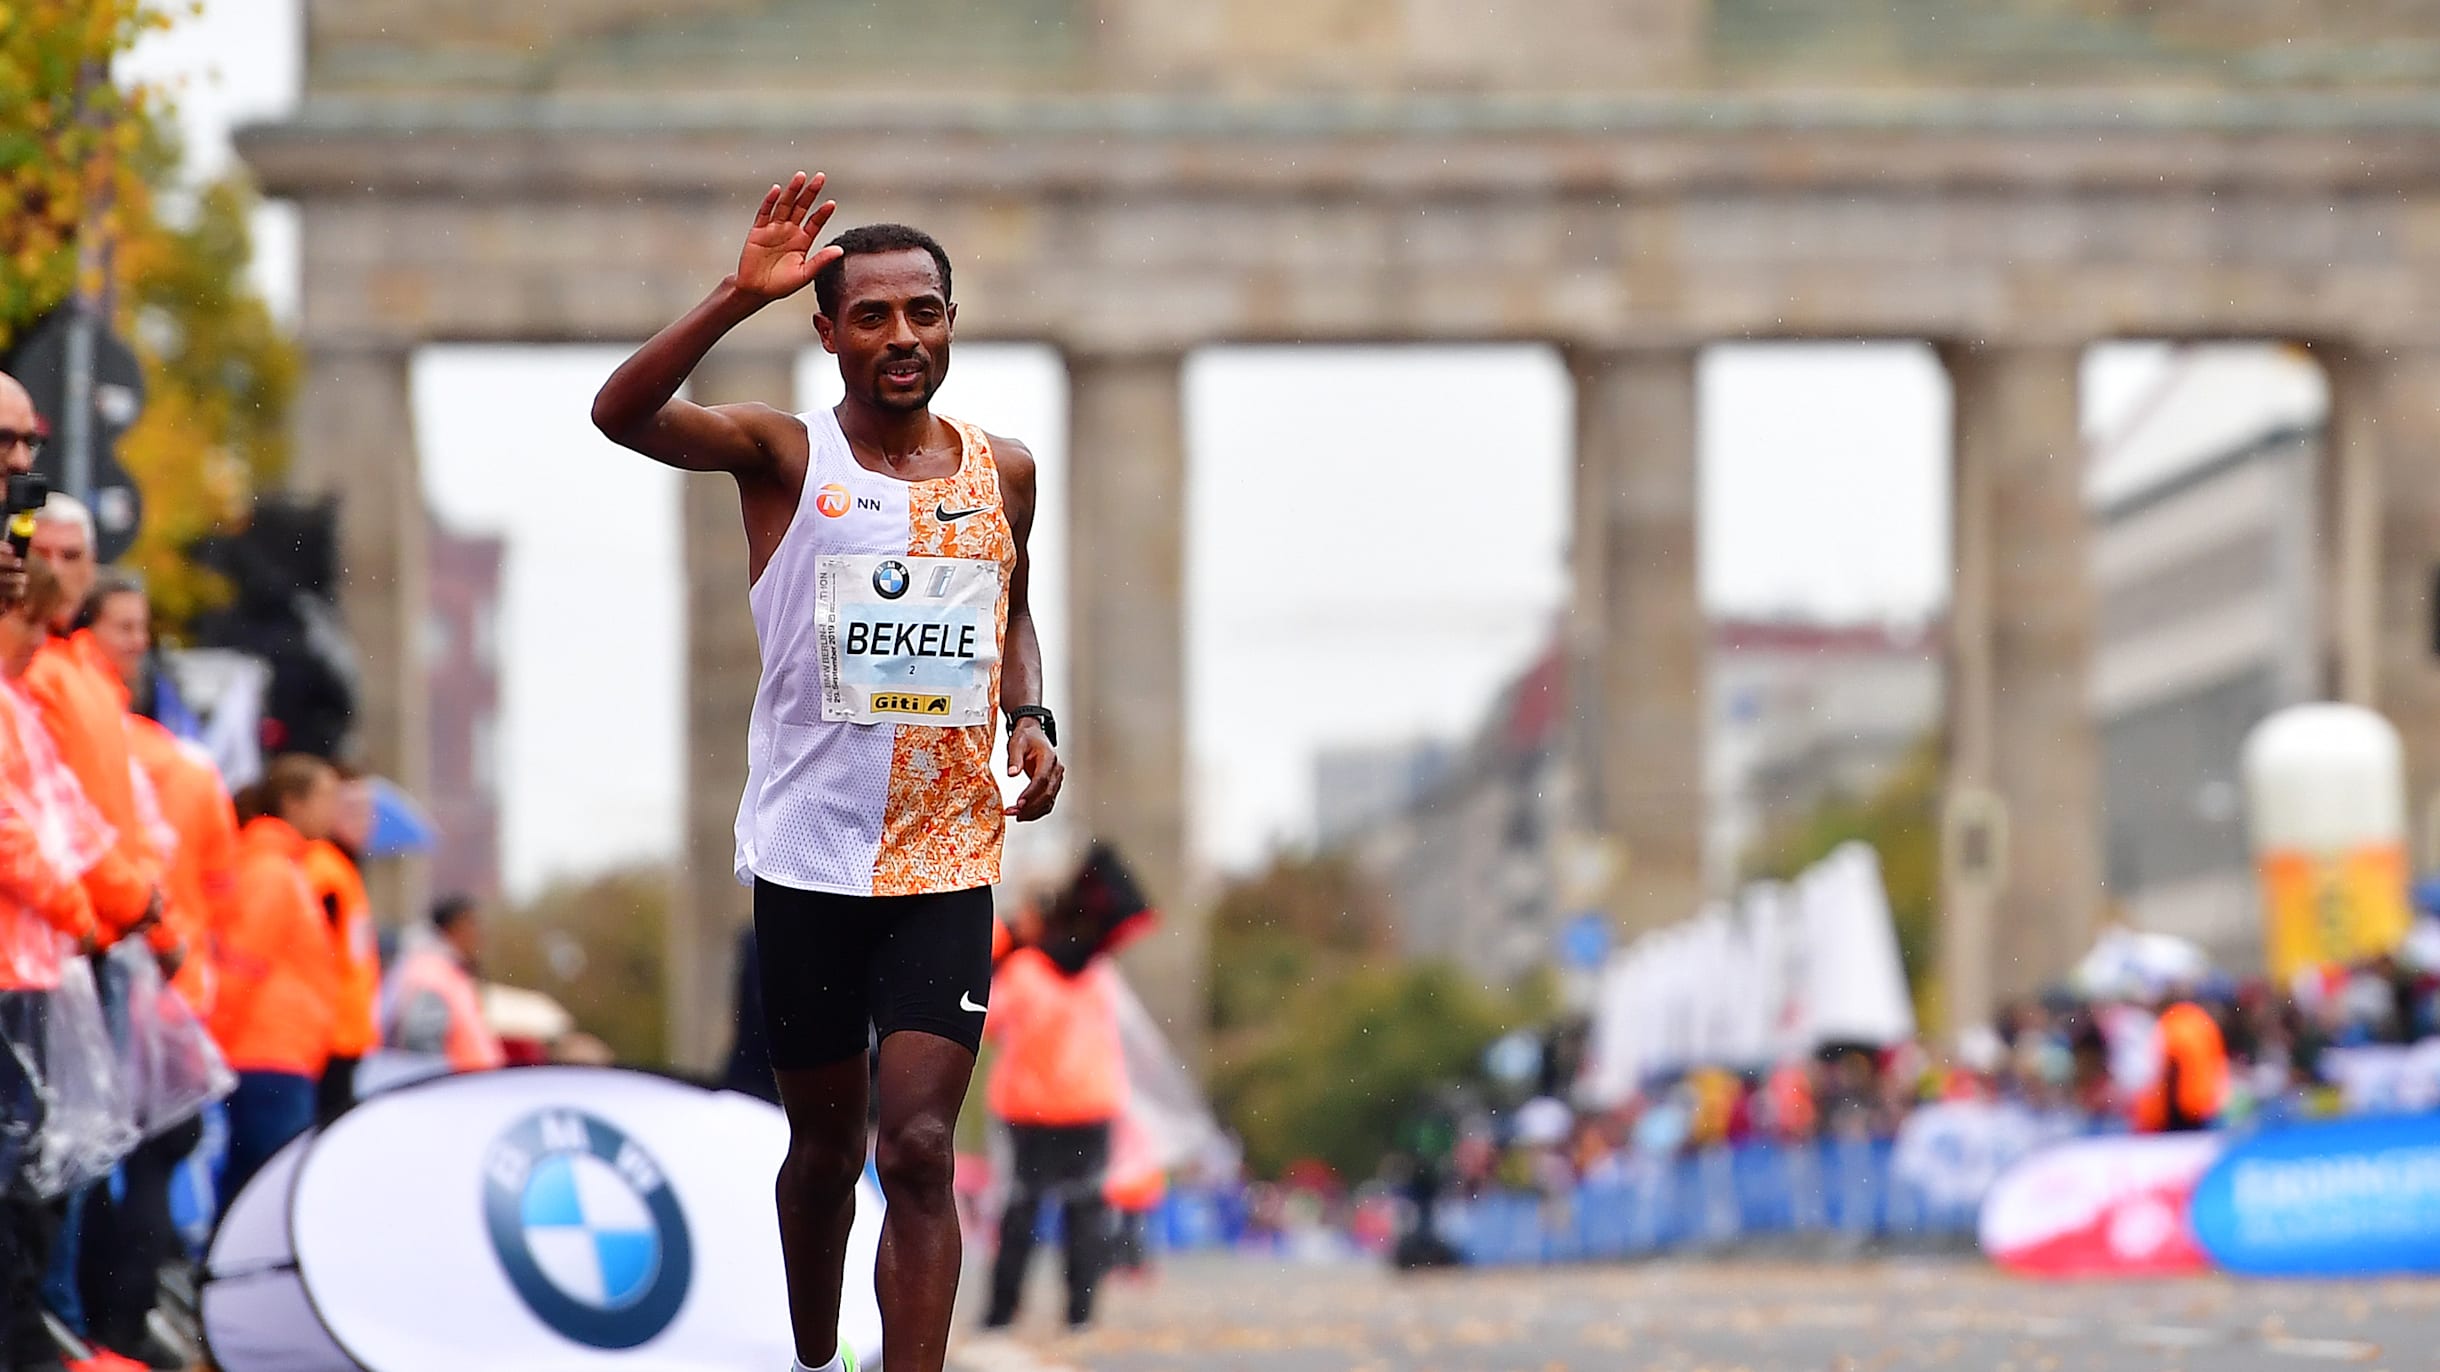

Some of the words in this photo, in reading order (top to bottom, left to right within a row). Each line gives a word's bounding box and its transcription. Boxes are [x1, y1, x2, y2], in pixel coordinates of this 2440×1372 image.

[857, 497, 880, 511] NN
[828, 625, 836, 644] 2019
[846, 621, 975, 658] BEKELE
[831, 647, 839, 689] September
[909, 665, 916, 675] 2
[875, 696, 919, 710] Giti
